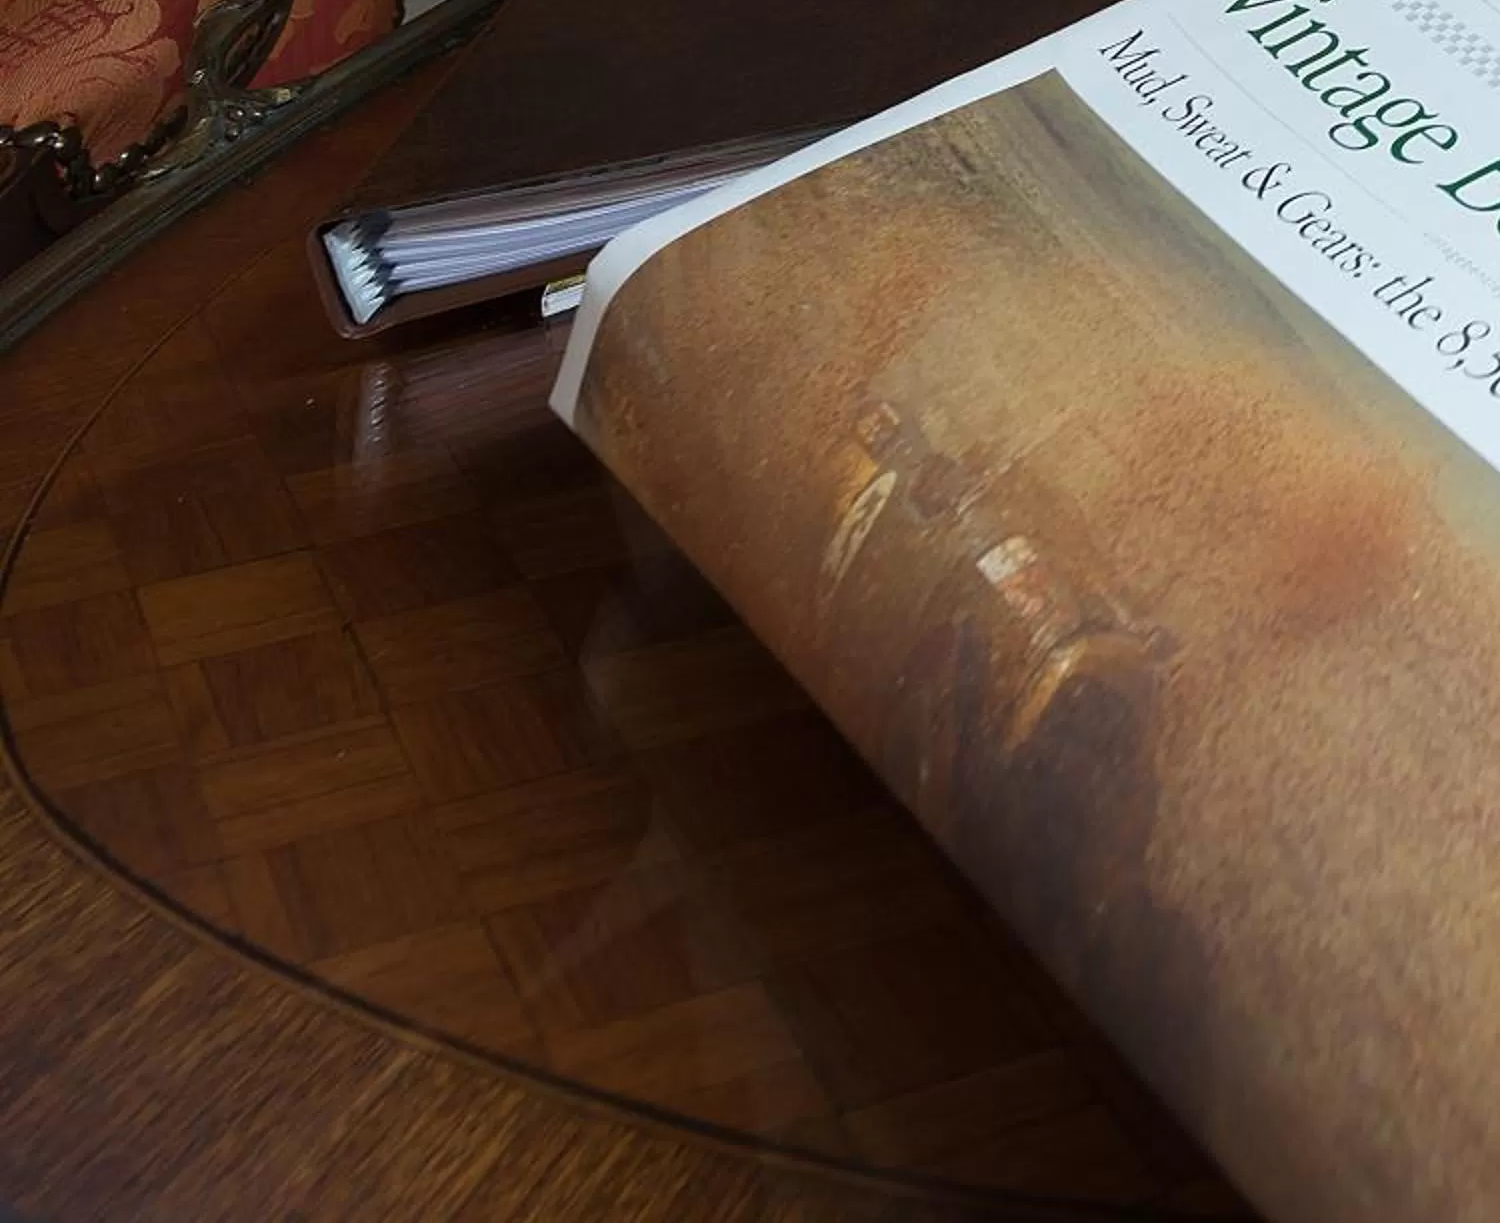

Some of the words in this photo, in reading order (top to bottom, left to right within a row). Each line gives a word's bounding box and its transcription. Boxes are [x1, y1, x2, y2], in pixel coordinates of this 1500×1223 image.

[1099, 29, 1188, 107] Mud,
[1163, 94, 1252, 172] Sweat
[1242, 161, 1291, 200] &
[1276, 189, 1382, 279] Gears:
[1373, 275, 1442, 332] the
